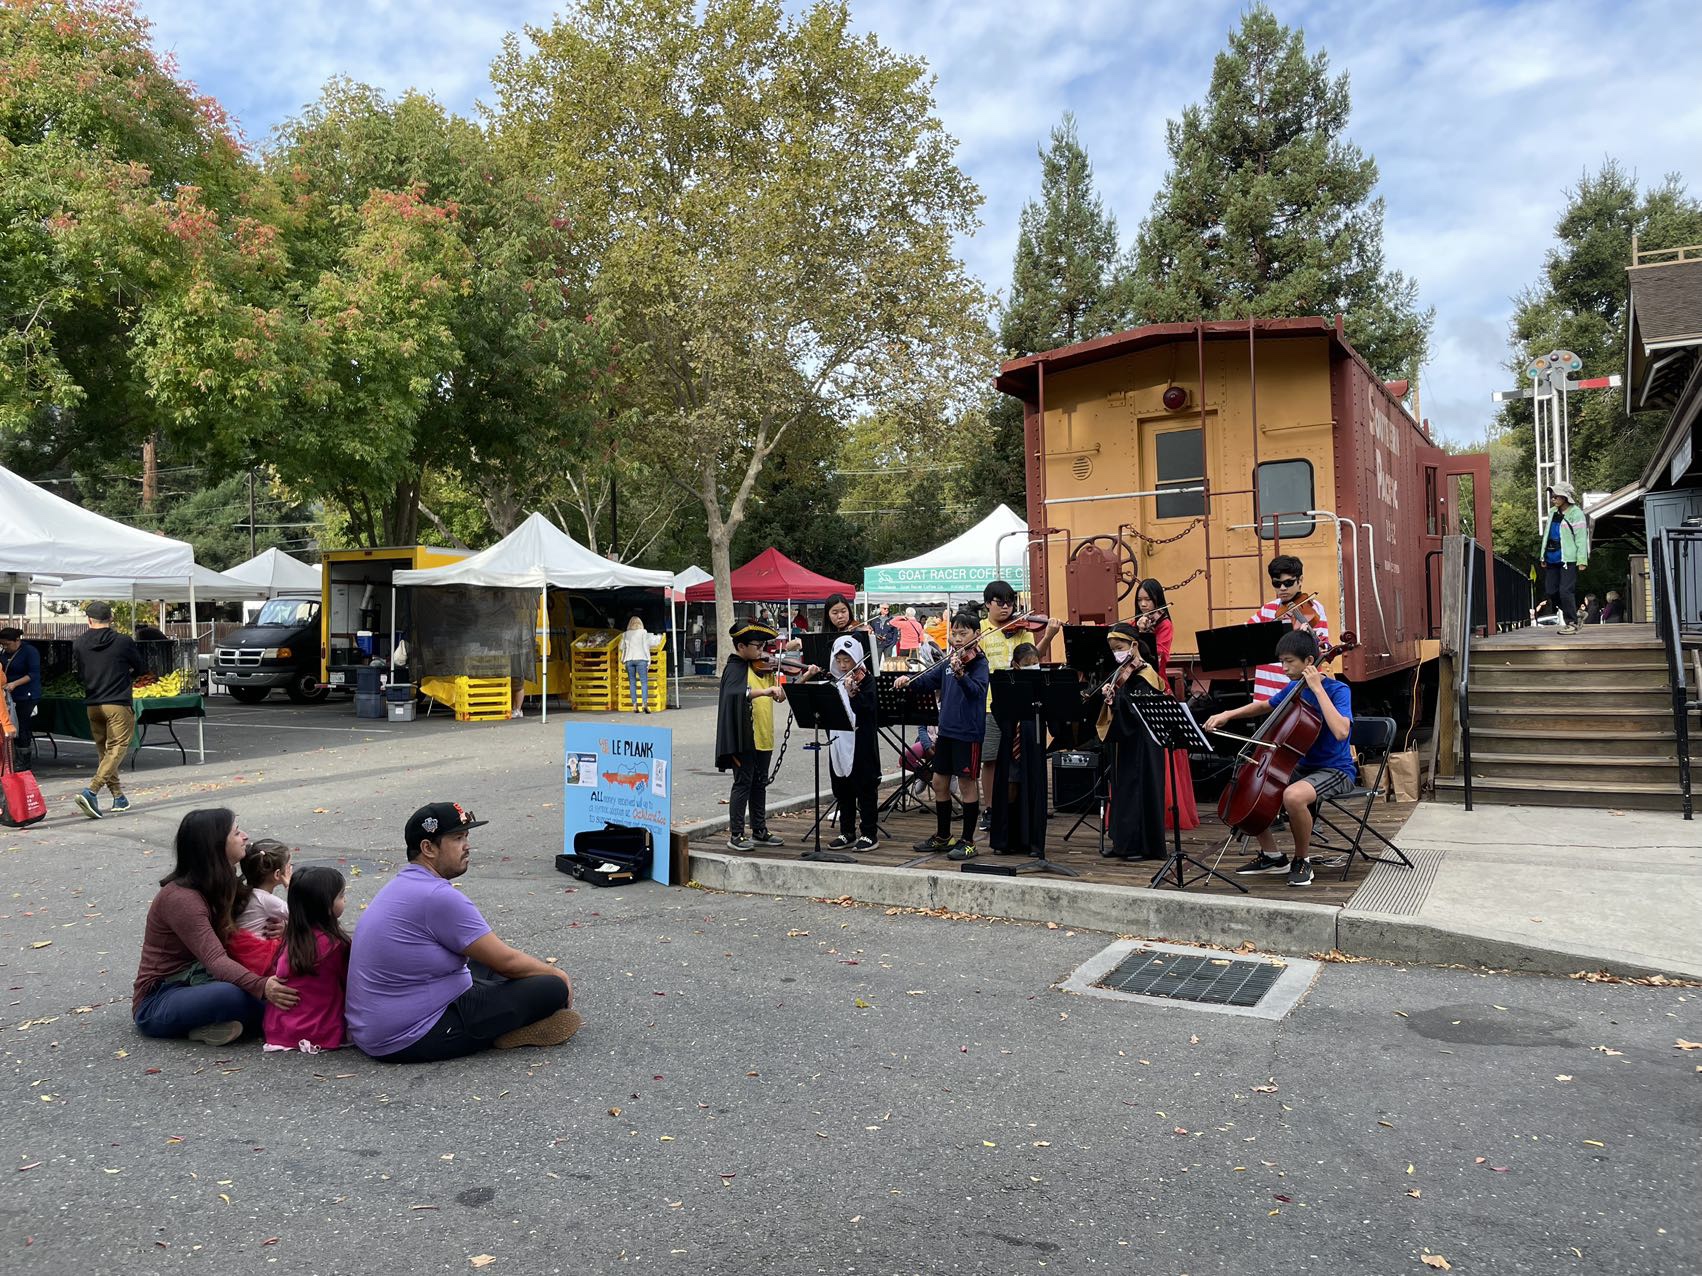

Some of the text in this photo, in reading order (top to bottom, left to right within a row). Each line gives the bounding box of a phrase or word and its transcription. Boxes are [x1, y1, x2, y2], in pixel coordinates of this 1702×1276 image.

[898, 569, 927, 580] GOAT
[930, 568, 966, 580] RACER
[969, 568, 1014, 579] COFFEE
[623, 740, 654, 759] PLANK
